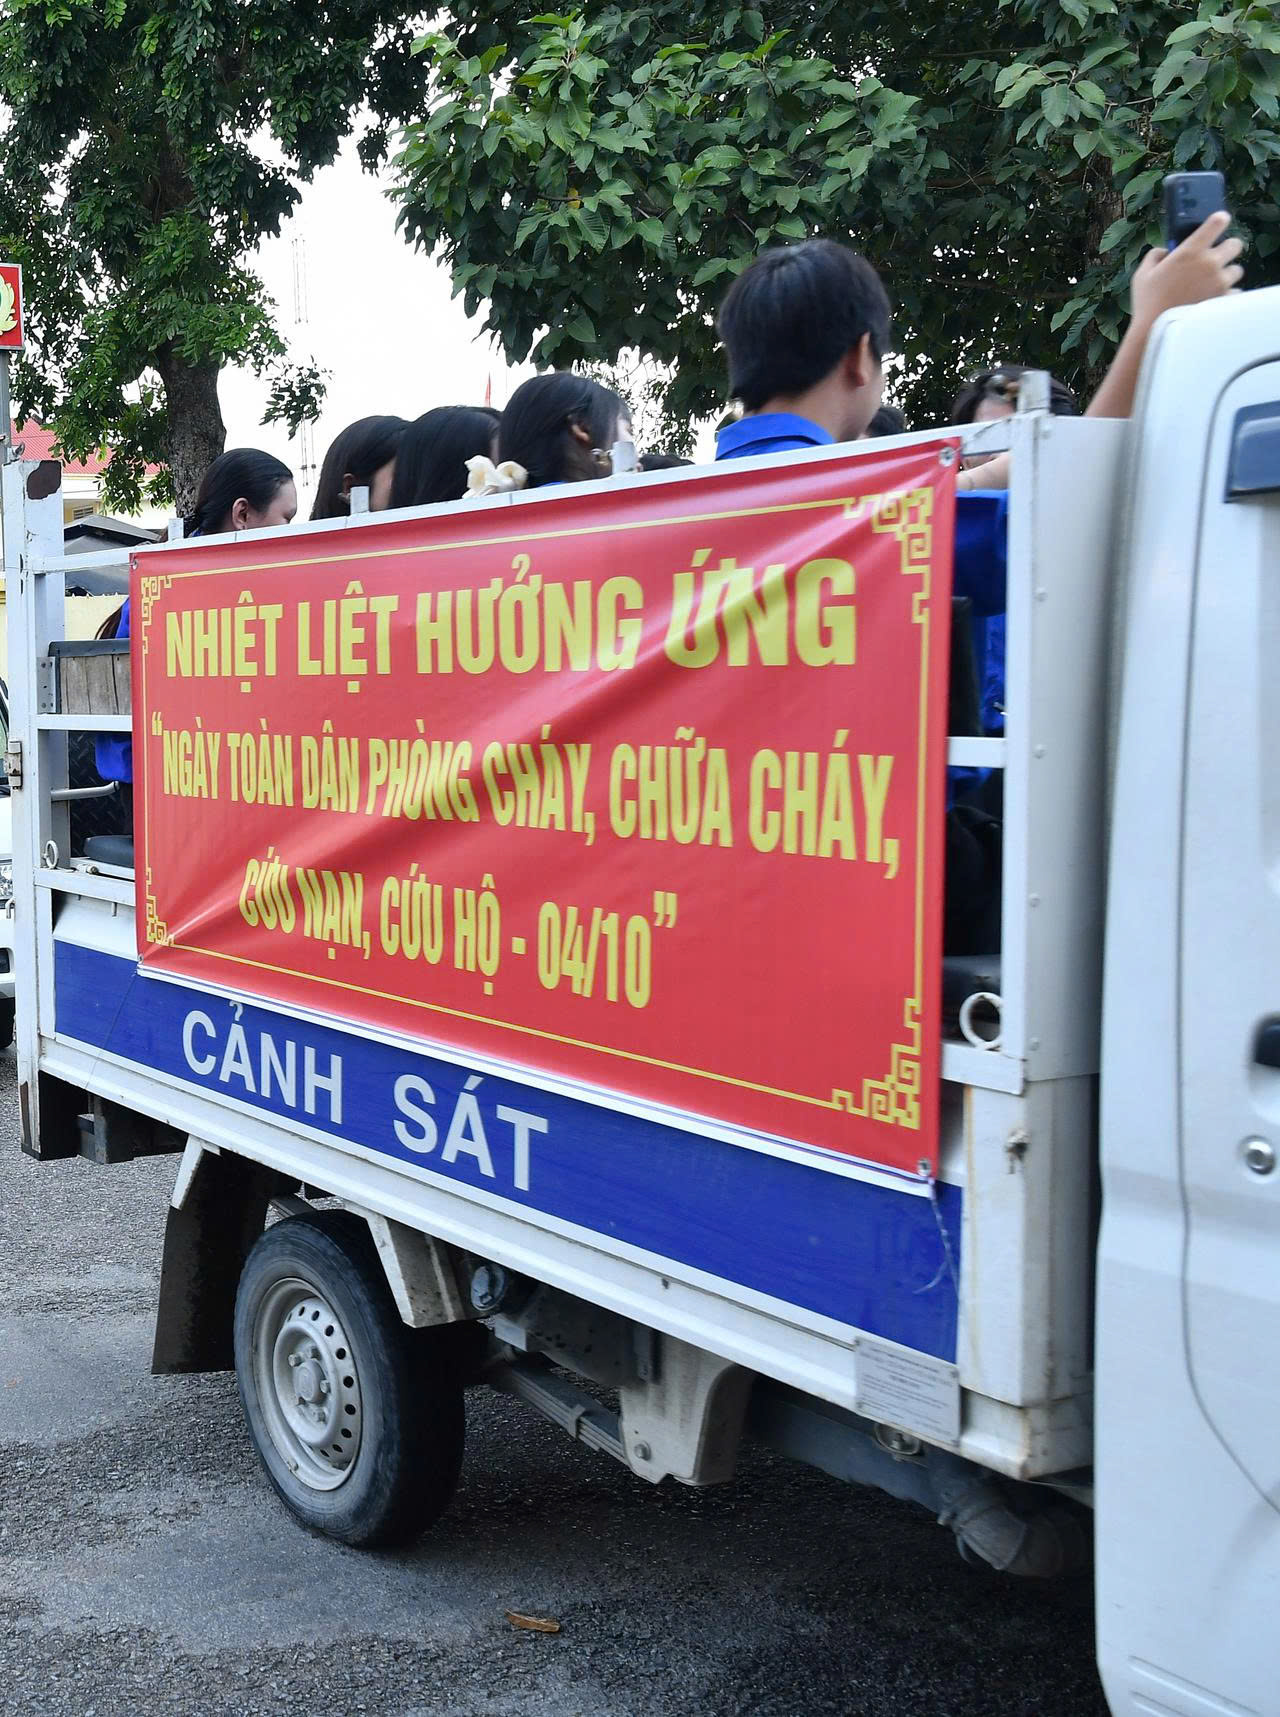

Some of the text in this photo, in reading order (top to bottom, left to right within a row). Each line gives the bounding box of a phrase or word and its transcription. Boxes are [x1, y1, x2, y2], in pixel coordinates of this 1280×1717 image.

[166, 547, 857, 693] NHIỆT LIỆT HƯỞNG ỨNG
[227, 718, 294, 807] TOÀN
[300, 719, 360, 814] DÂN
[365, 718, 481, 823] PHÒNG
[482, 724, 596, 846] CHÁY,
[609, 726, 734, 848] CHỮA
[748, 728, 900, 880] CHÁY,
[239, 846, 297, 935] CỨU
[296, 867, 370, 960] NẠN,
[380, 863, 444, 966] CỨU
[453, 873, 500, 996] HỘ
[182, 1000, 549, 1192] CẢNH SÁT
